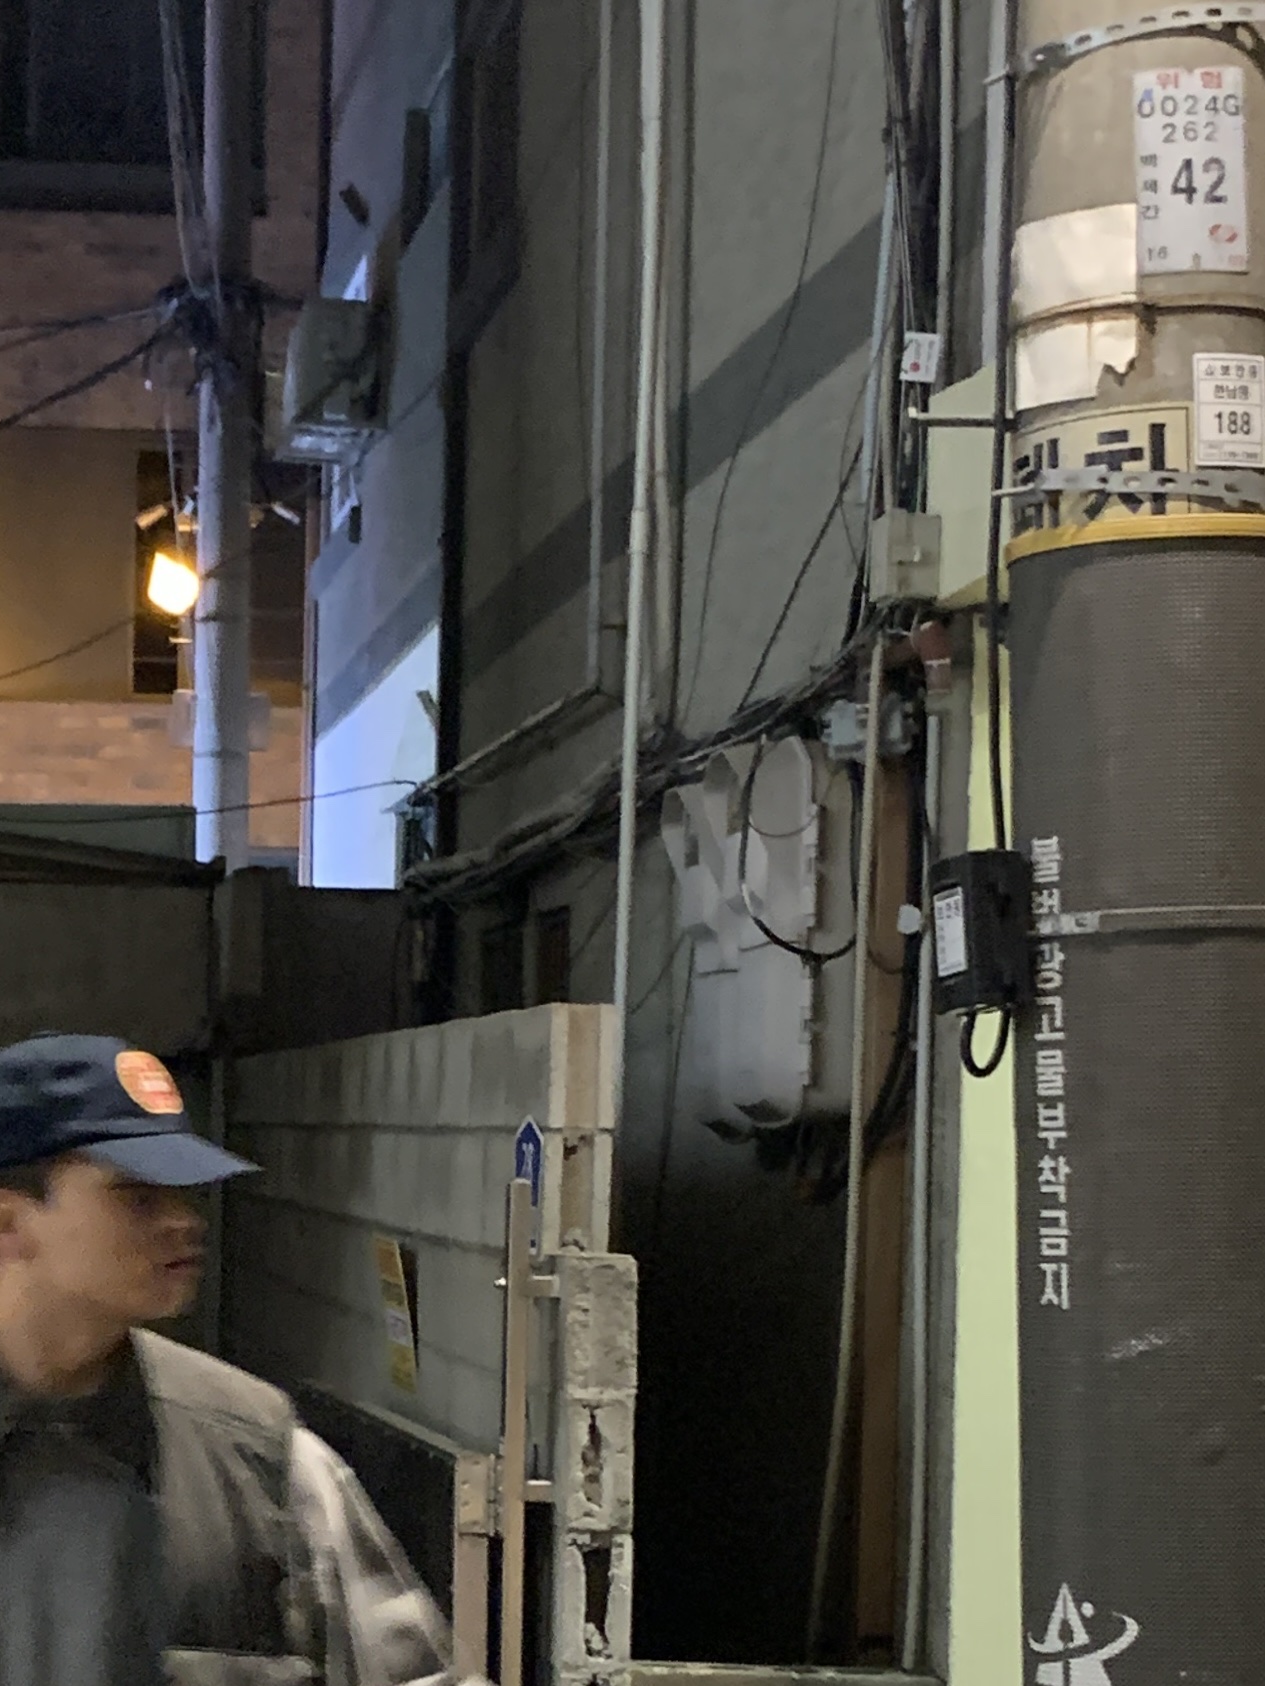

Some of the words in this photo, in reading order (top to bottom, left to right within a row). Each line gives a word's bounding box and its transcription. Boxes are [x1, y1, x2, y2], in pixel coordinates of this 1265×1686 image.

[1162, 122, 1220, 143] 262
[1170, 156, 1229, 205] 42
[1214, 410, 1251, 435] 188
